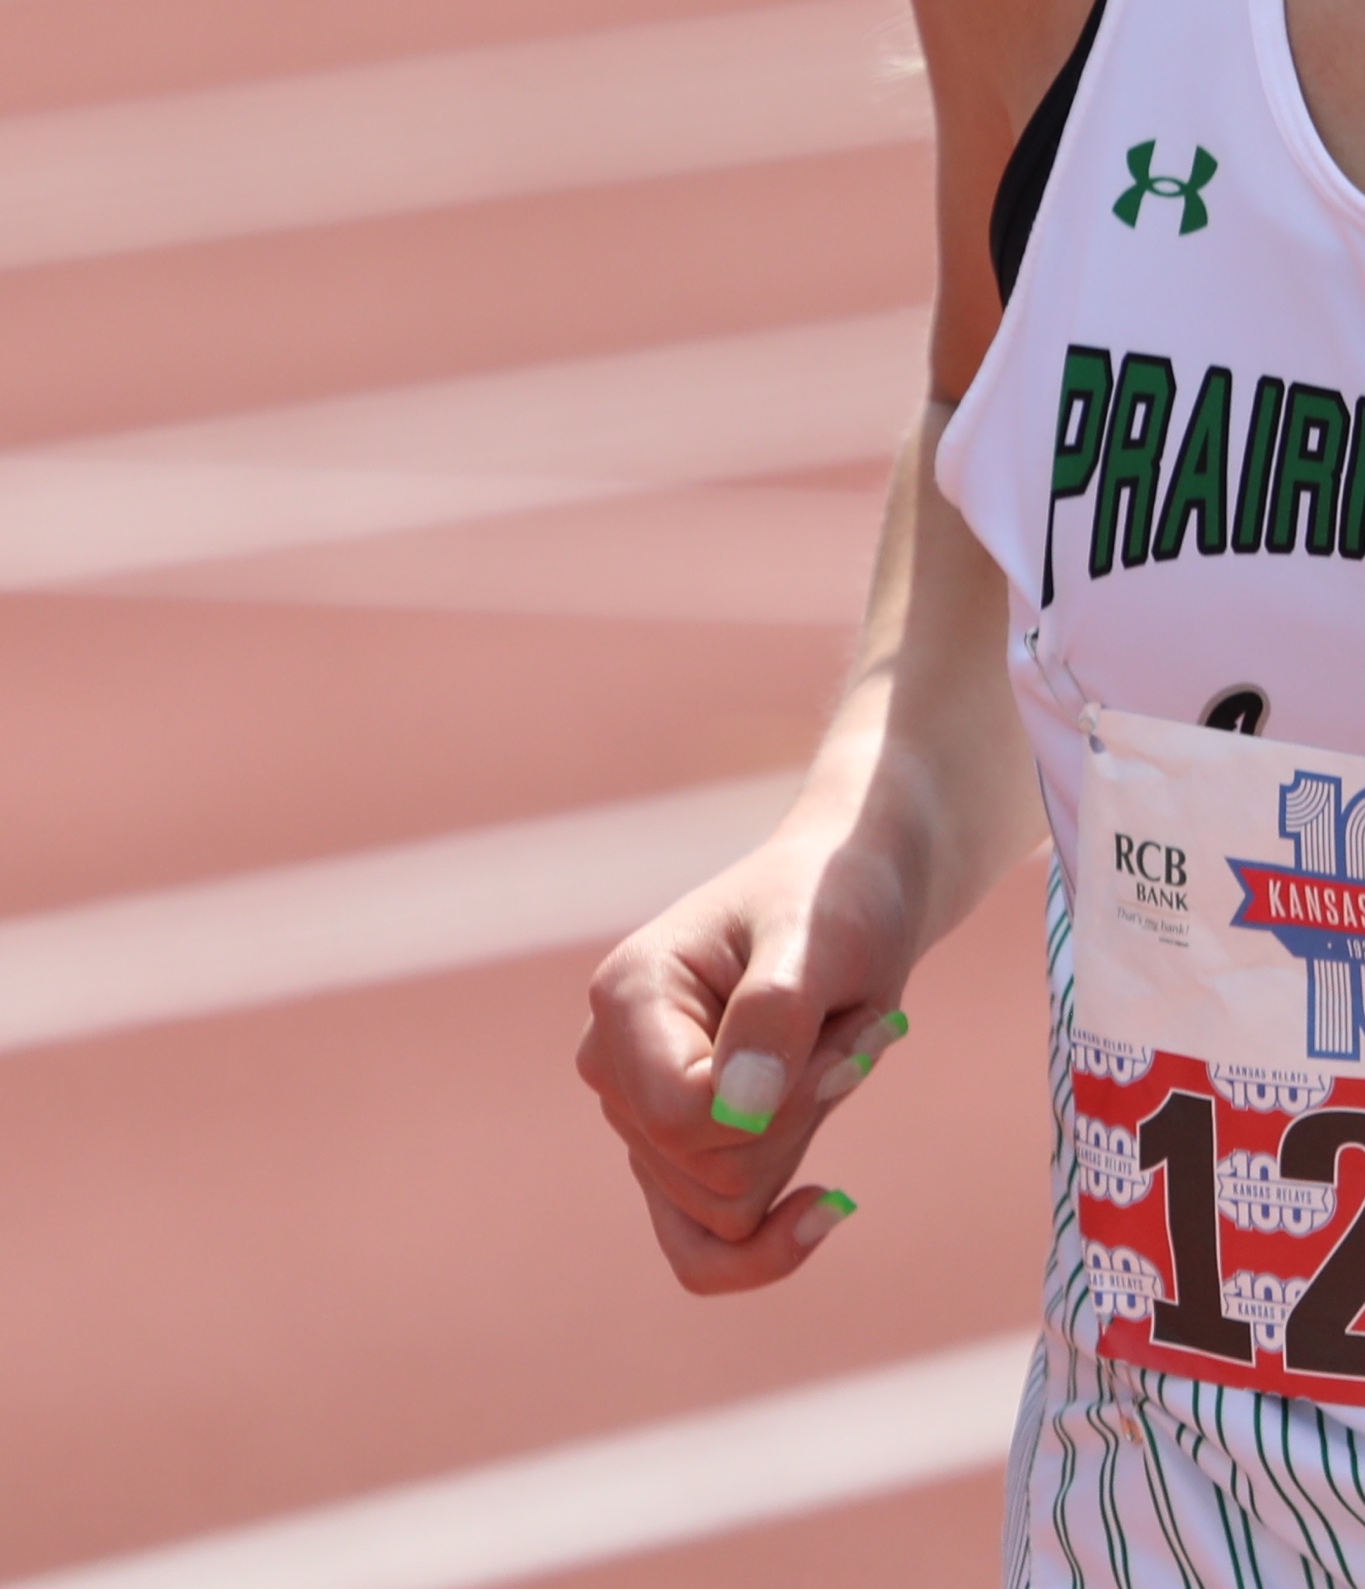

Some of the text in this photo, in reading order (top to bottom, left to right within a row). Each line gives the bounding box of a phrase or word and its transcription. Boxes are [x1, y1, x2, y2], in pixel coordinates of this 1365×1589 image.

[1114, 832, 1188, 887] RCB
[1136, 882, 1189, 912] BANK
[1233, 1182, 1312, 1205] KANSAS RELAYS
[1238, 1301, 1275, 1319] KANSAS
